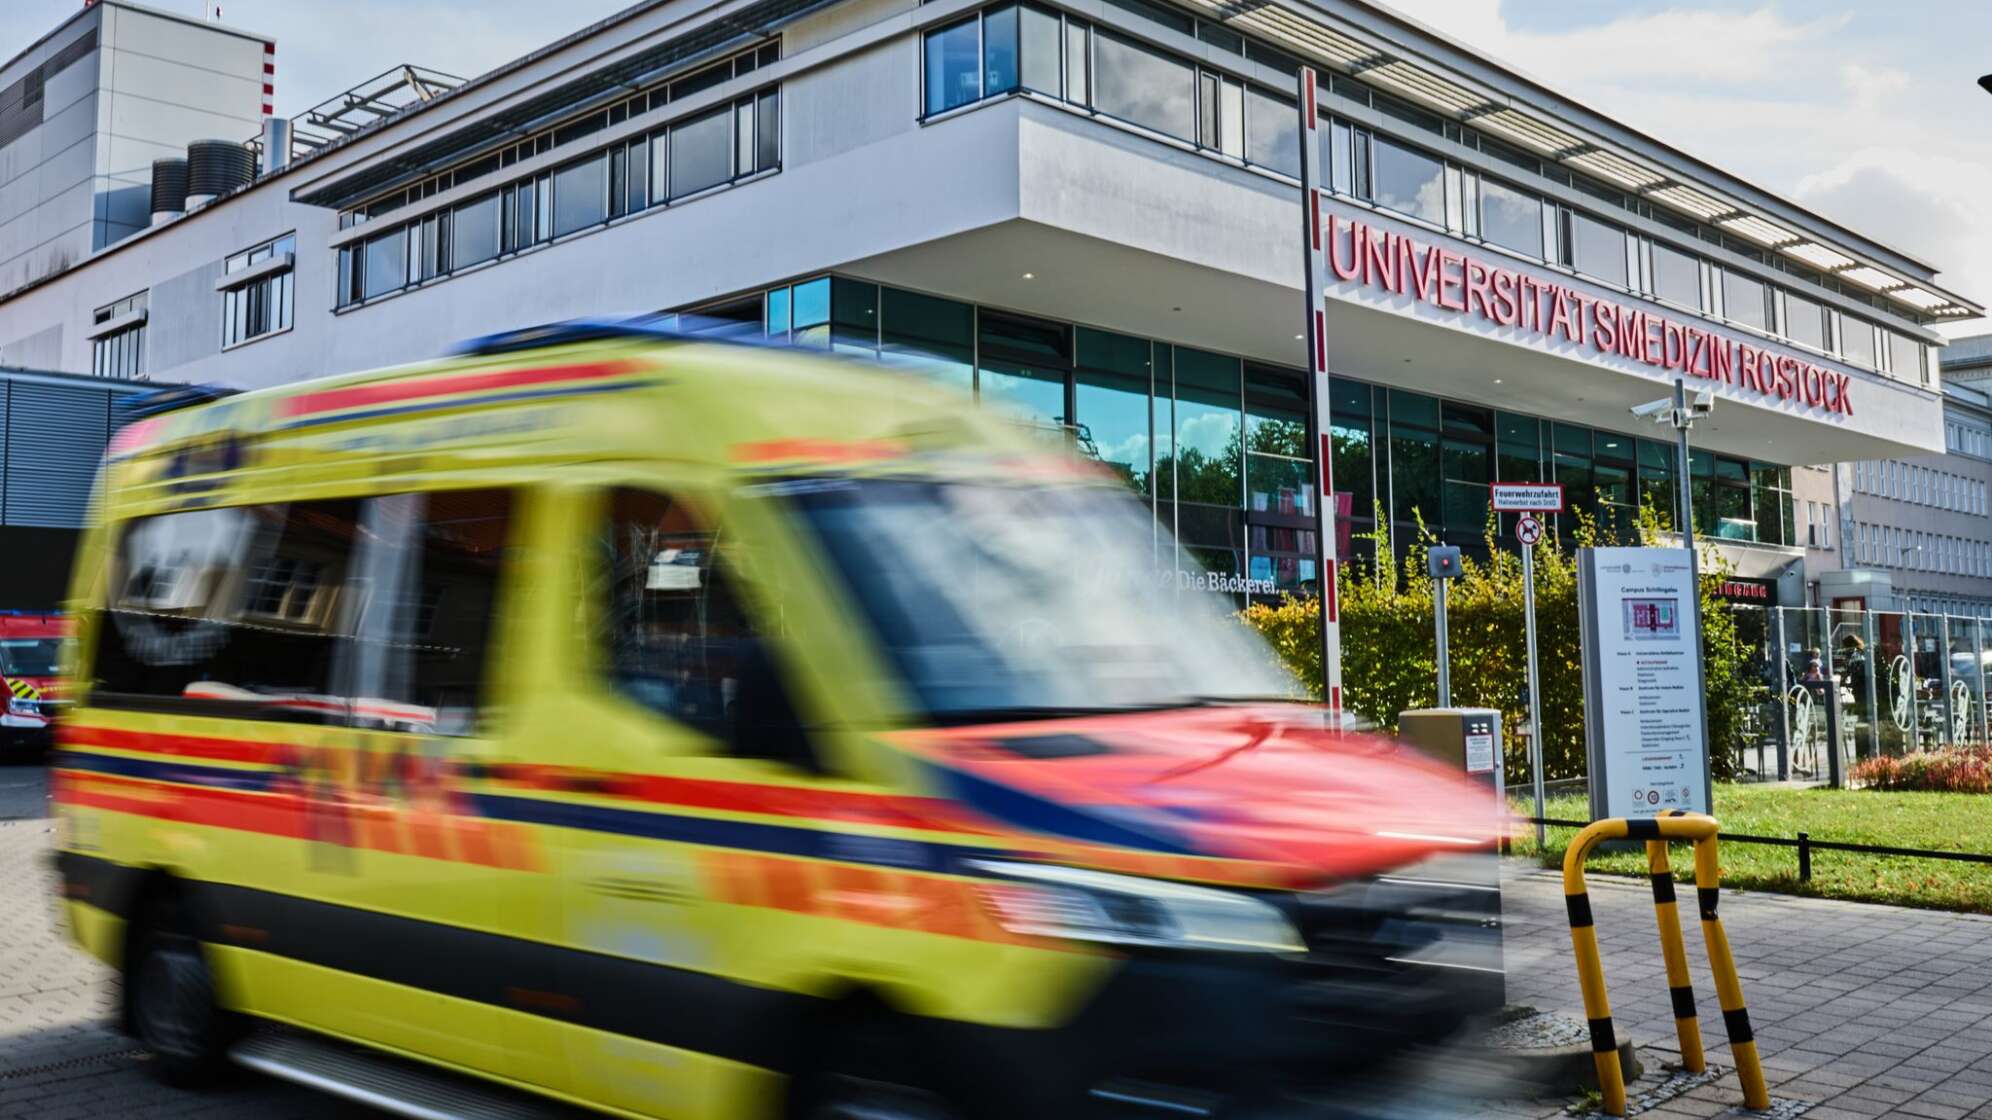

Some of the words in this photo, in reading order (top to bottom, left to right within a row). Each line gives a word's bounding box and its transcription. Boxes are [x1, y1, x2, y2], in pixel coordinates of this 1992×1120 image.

[1328, 214, 1732, 384] UNIVERSITÄTSMEDIZIN
[1739, 343, 1853, 416] ROSTOCK
[1495, 488, 1559, 498] Feuerwehrzufahrt
[1177, 570, 1206, 591] Die
[1207, 572, 1281, 595] Bäckerei.
[1621, 586, 1645, 594] Campus
